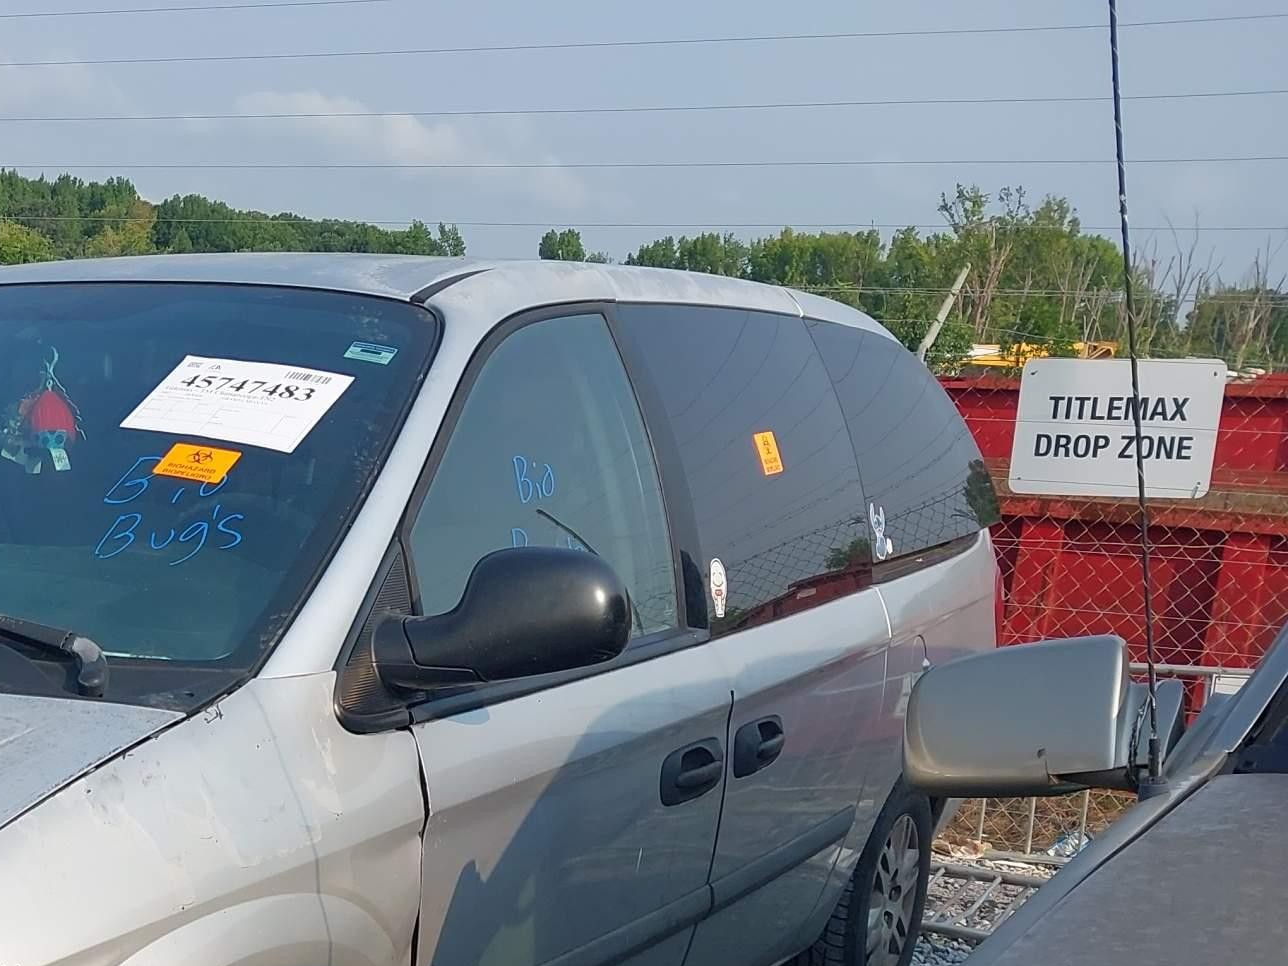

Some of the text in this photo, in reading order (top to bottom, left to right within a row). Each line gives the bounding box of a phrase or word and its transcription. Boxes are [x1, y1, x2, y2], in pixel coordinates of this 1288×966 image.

[180, 374, 316, 402] 45747483
[1049, 396, 1190, 422] TITLEMAX
[1033, 433, 1194, 461] DROP ZONE
[167, 462, 217, 475] BIOHAZARD
[95, 504, 244, 566] Bug's
